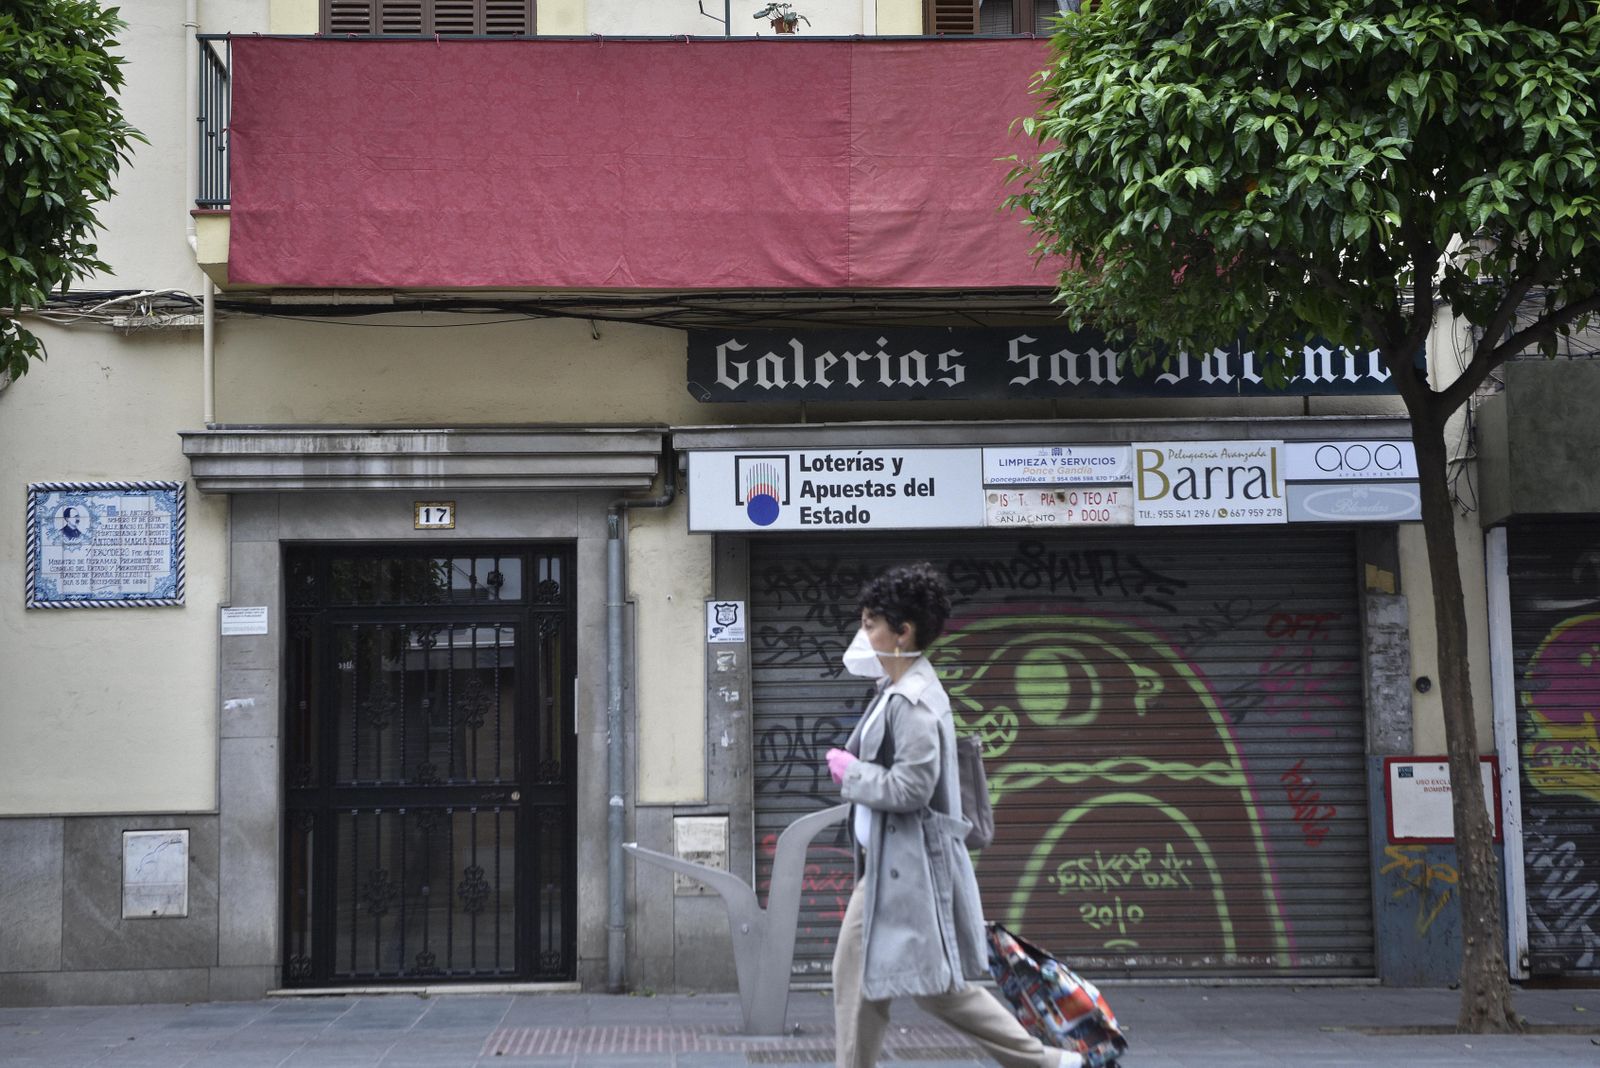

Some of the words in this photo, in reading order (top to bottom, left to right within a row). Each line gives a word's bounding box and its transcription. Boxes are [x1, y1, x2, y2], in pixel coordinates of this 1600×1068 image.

[714, 336, 966, 390] Galerias
[1007, 333, 1124, 386] San
[800, 451, 884, 472] Loterías
[892, 457, 904, 476] y
[999, 458, 1048, 467] LIMPIEZA
[1051, 458, 1058, 466] Y
[1060, 457, 1116, 466] SERVICIOS
[1221, 448, 1267, 463] Avanzada
[1022, 467, 1054, 475] Ponce
[1136, 447, 1281, 501] Barral
[800, 480, 896, 503] Apuestas
[903, 478, 935, 497] del
[424, 507, 447, 522] 17
[800, 505, 871, 525] Estado
[1157, 510, 1174, 518] 955
[1176, 509, 1191, 518] 541
[1194, 509, 1210, 518] 296
[1230, 509, 1246, 517] 667
[1248, 508, 1264, 517] 959
[1266, 508, 1283, 517] 278
